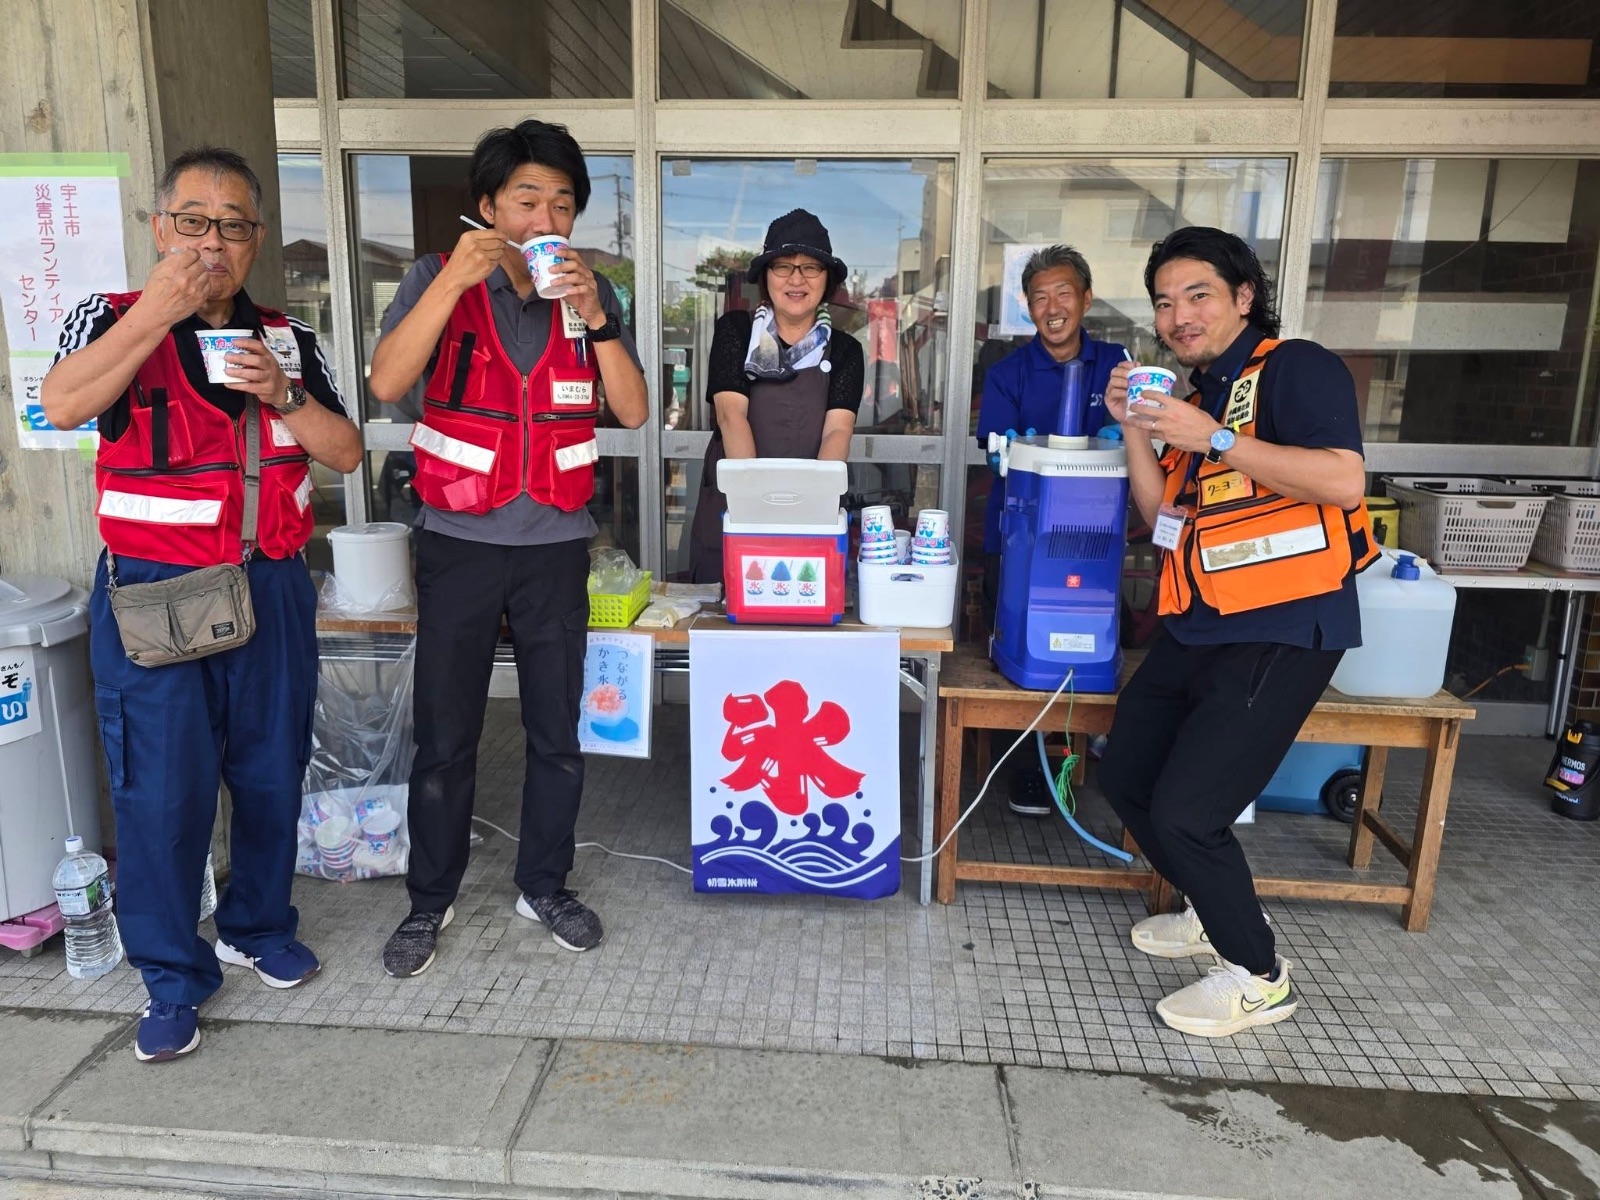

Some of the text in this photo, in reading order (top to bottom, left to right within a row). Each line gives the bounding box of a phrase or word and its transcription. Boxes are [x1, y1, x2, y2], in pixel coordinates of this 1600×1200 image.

[60, 184, 80, 237] 宇土市
[34, 184, 64, 323] 災害ボランティア
[18, 275, 38, 341] センター
[561, 385, 587, 394] いまむら
[1, 672, 19, 689] ぞ
[617, 650, 629, 701] つながる
[1, 700, 24, 721] い
[720, 679, 866, 816] 氷
